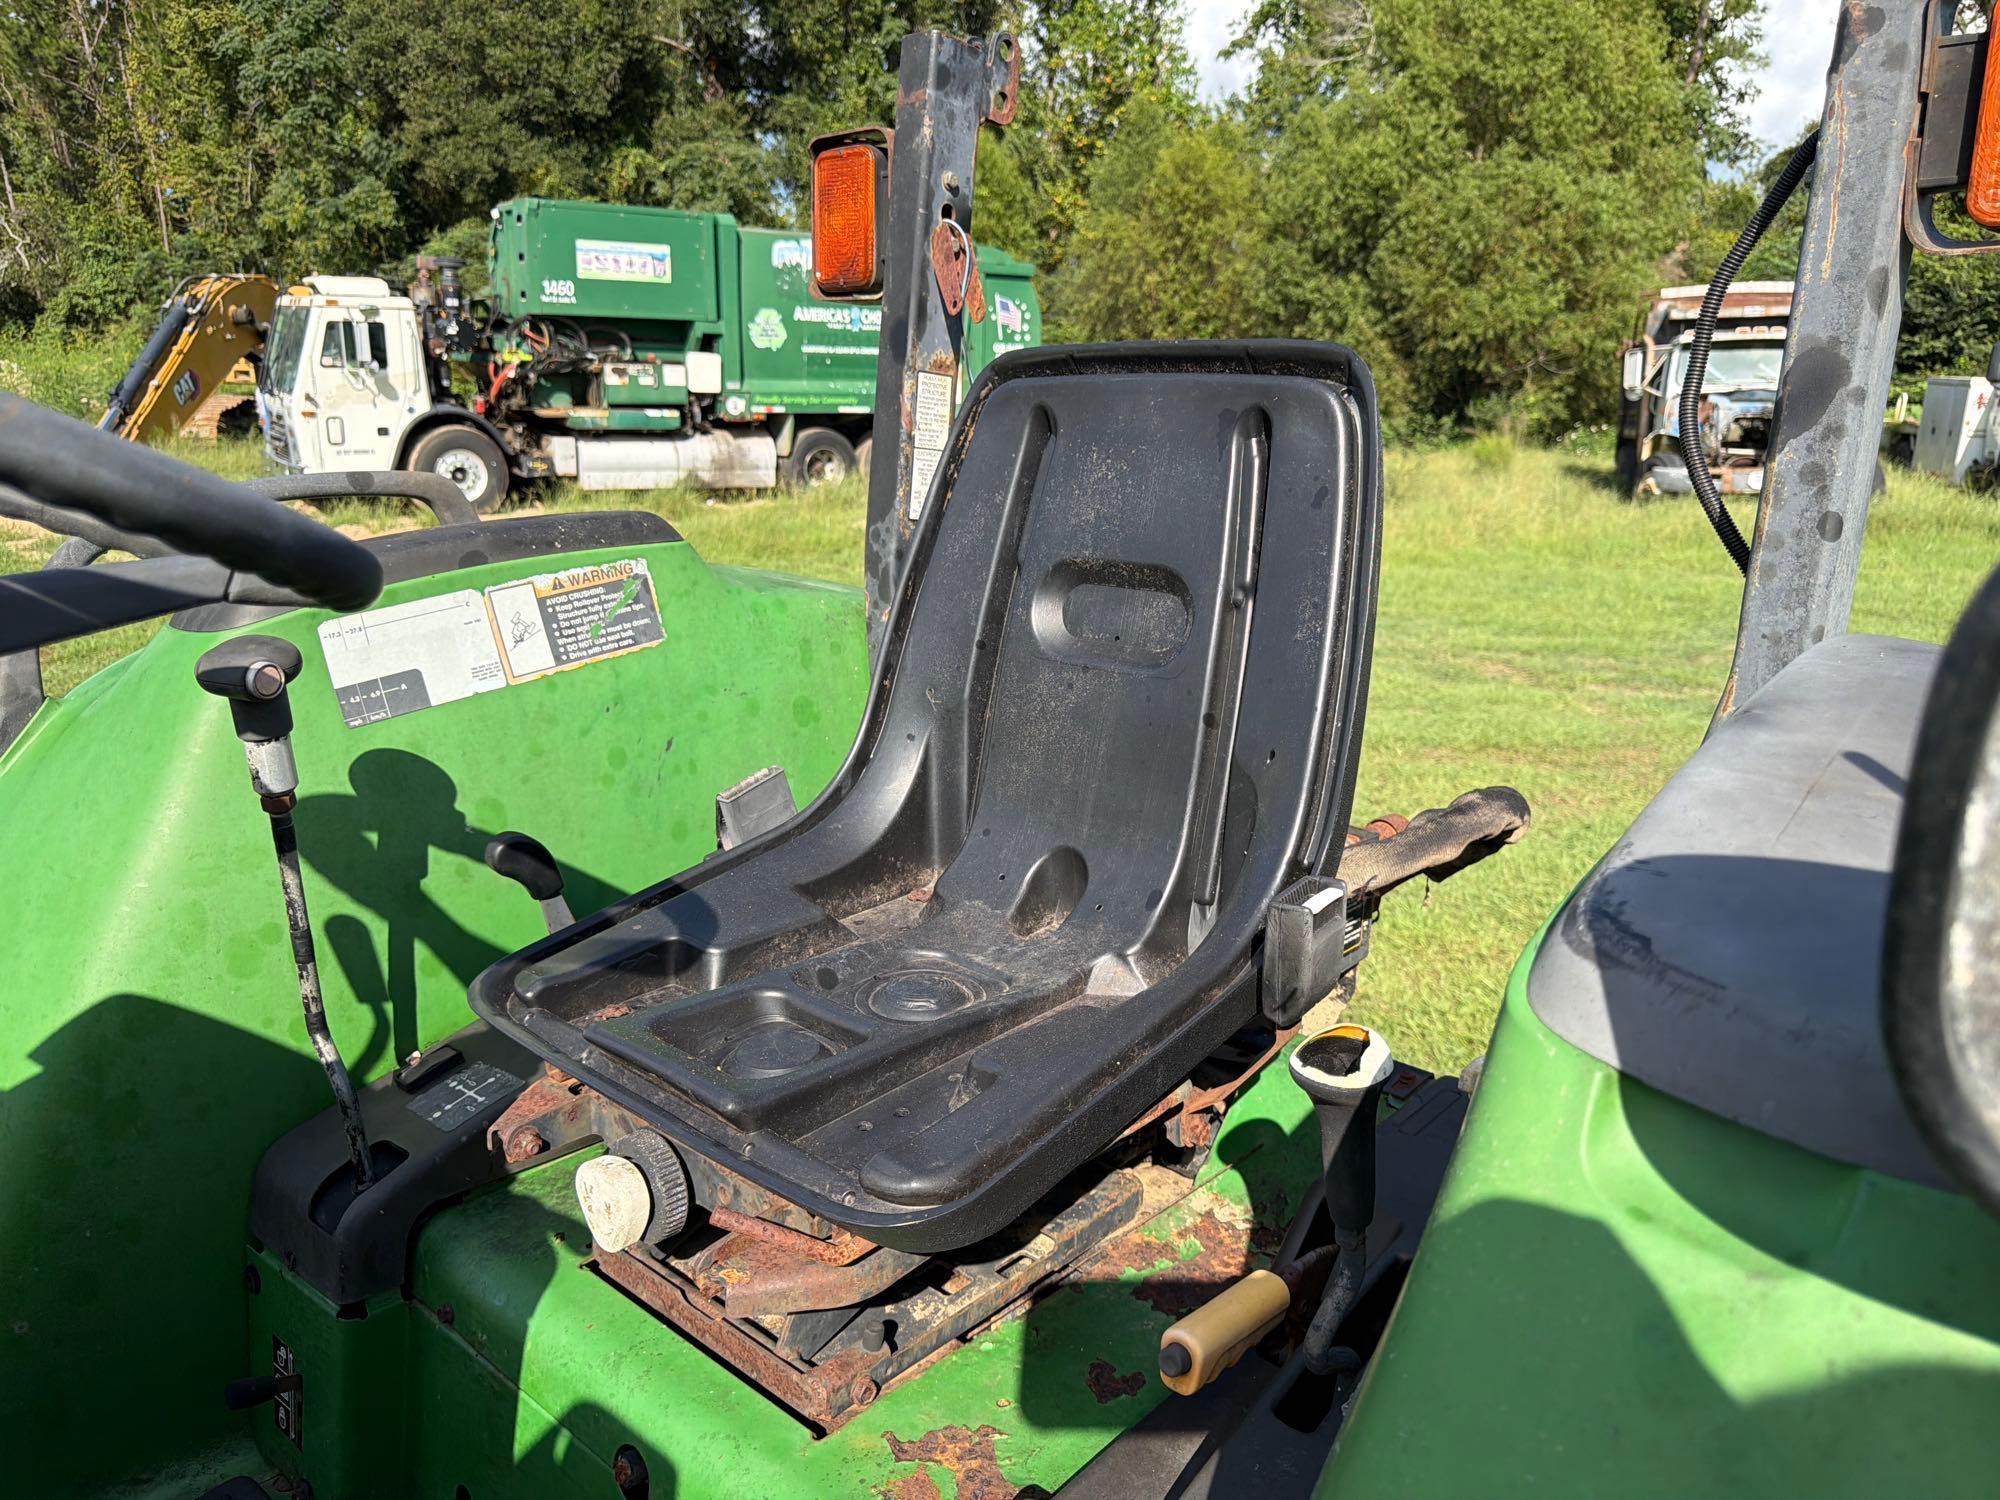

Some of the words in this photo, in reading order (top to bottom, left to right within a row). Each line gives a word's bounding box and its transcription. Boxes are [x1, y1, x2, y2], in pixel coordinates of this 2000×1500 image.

[542, 280, 575, 297] 1460
[173, 371, 195, 406] CAT
[567, 563, 634, 587] WARNING
[546, 595, 568, 606] AVOID
[555, 603, 573, 612] Keep
[573, 597, 600, 608] Rollover
[557, 608, 588, 620] Structure
[588, 604, 602, 613] fully
[570, 617, 582, 625] not
[582, 614, 599, 624] jump
[556, 637, 577, 646] When
[606, 624, 623, 633] must
[561, 628, 576, 636] Use
[567, 643, 578, 651] DO
[578, 639, 593, 649] NOT
[593, 637, 607, 645] use
[607, 632, 621, 641] seat
[569, 650, 587, 659] Drive
[587, 646, 602, 656] with
[602, 642, 618, 651] extra
[618, 638, 635, 647] care.
